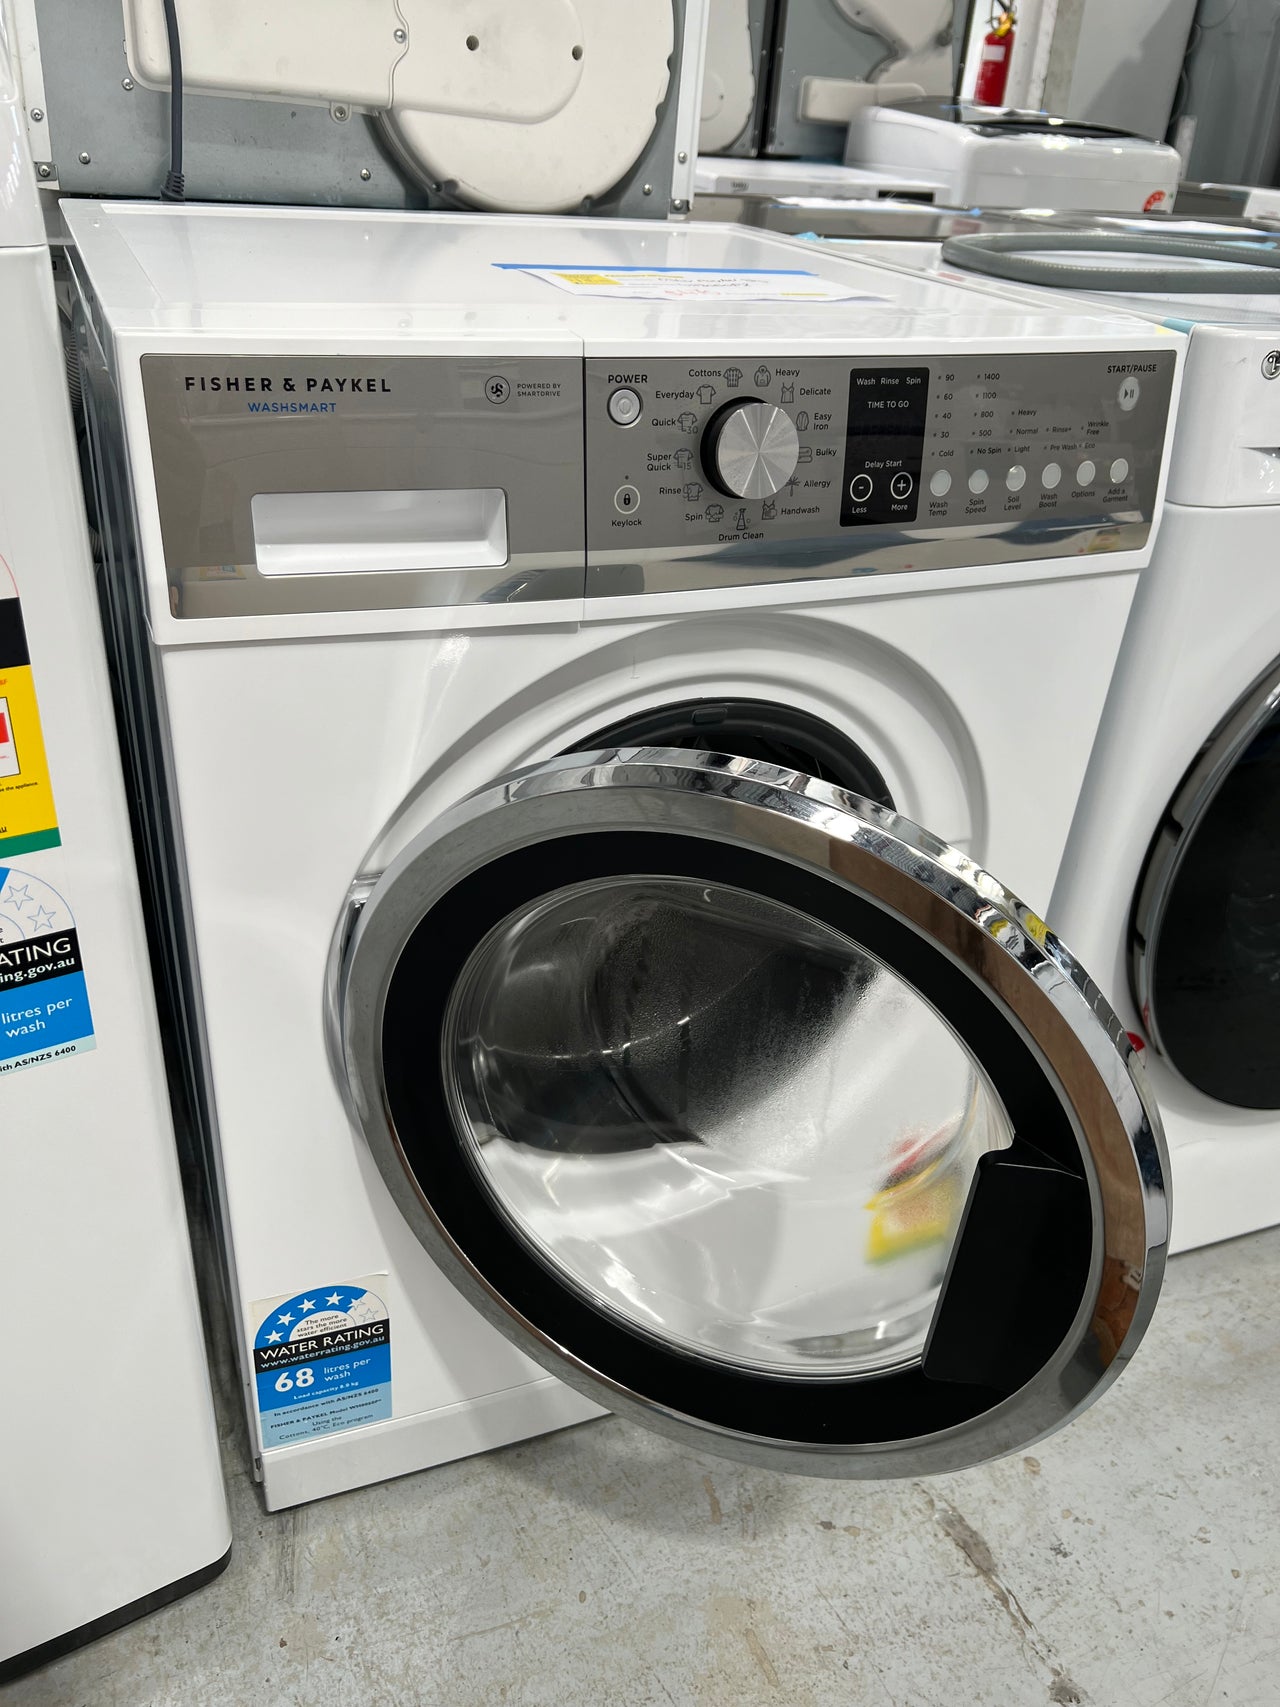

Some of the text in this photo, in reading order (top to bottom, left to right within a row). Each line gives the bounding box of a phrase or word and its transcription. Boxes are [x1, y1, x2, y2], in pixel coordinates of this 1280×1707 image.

[688, 368, 721, 377] Cottons
[775, 368, 800, 378] Heavy
[1107, 363, 1157, 374] START/PAUSE
[608, 374, 648, 384] POWER
[856, 376, 922, 386] Wash Rinse Spin
[185, 376, 392, 393] FISHER & PAYKEL
[655, 390, 695, 400] Everyday
[800, 387, 832, 396] Delicate
[247, 402, 337, 413] WASHSMART
[867, 401, 885, 409] TIME
[898, 400, 909, 408] GO
[814, 413, 832, 422] Easy
[1017, 409, 1037, 417] Heavy
[651, 417, 676, 427] Quick
[978, 429, 992, 437] 500
[1016, 427, 1038, 435] Normal
[815, 448, 837, 457] Bulky
[977, 447, 1002, 455] No Spin
[1014, 445, 1030, 453] Light
[647, 453, 672, 463] Super
[646, 463, 672, 472] Quick
[864, 459, 902, 469] Delay Start
[803, 479, 831, 489] Allergy
[659, 486, 682, 495] Rinse
[1071, 490, 1096, 498] Options
[1040, 493, 1058, 501] Wash
[1102, 495, 1128, 503] Garment
[929, 500, 948, 508] Wash
[969, 498, 984, 506] Spin
[1038, 501, 1057, 509] Boost
[780, 505, 820, 515] Handwash
[852, 506, 867, 514] Less
[891, 503, 908, 511] More
[964, 506, 987, 514] Speed
[1003, 503, 1021, 511] Level
[685, 513, 703, 522] Spin
[928, 509, 948, 517] Temp
[611, 518, 642, 528] Keylock
[718, 532, 764, 541] Drum Clean
[1, 997, 73, 1025] litres per
[5, 1019, 46, 1038] wash
[14, 1051, 52, 1068] AS/NZS
[54, 1045, 76, 1057] 6400
[320, 1314, 339, 1322] more
[296, 1325, 314, 1333] stars
[327, 1317, 348, 1326] more
[297, 1323, 348, 1338] water efficient
[259, 1324, 384, 1360] WATER RATING
[260, 1335, 385, 1369] www.waterrating.gov.au
[274, 1358, 372, 1393] 68 litres per
[323, 1370, 351, 1382] wash
